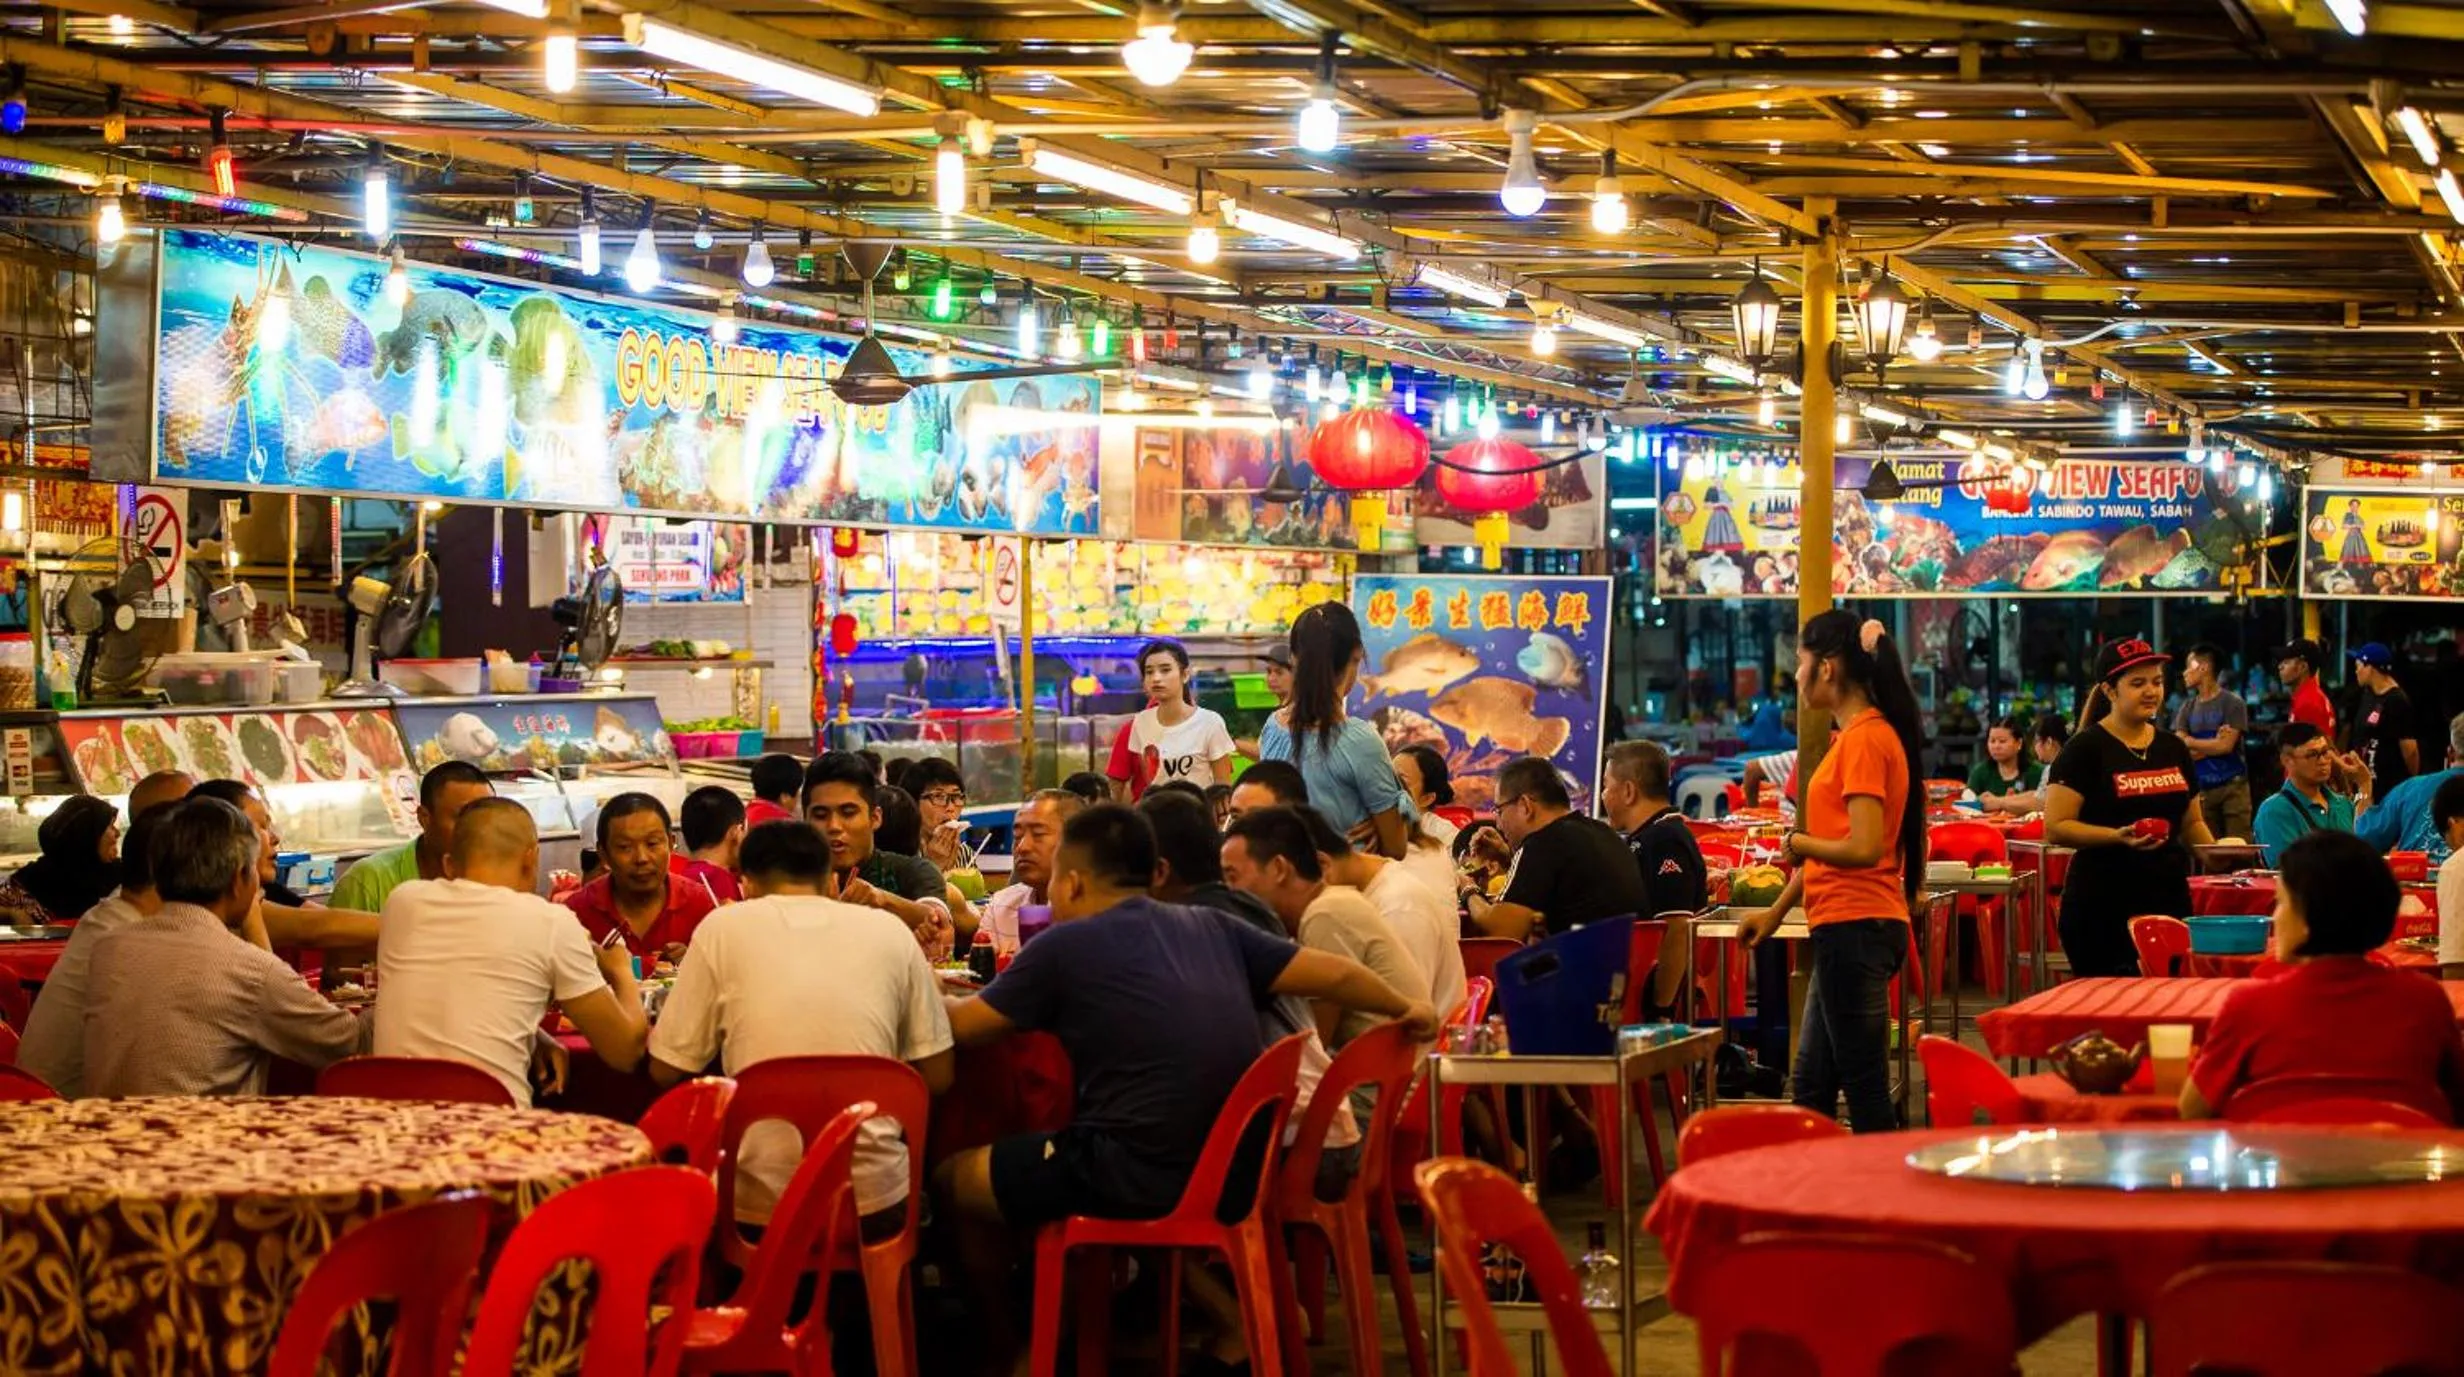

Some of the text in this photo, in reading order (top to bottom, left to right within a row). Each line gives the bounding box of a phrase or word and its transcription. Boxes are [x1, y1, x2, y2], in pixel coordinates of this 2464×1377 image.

[617, 328, 708, 412] GOOD
[2038, 505, 2095, 519] SABINDO
[2100, 506, 2145, 520] TAWAU,
[2151, 505, 2193, 518] SABAH
[2117, 772, 2184, 794] Supreme
